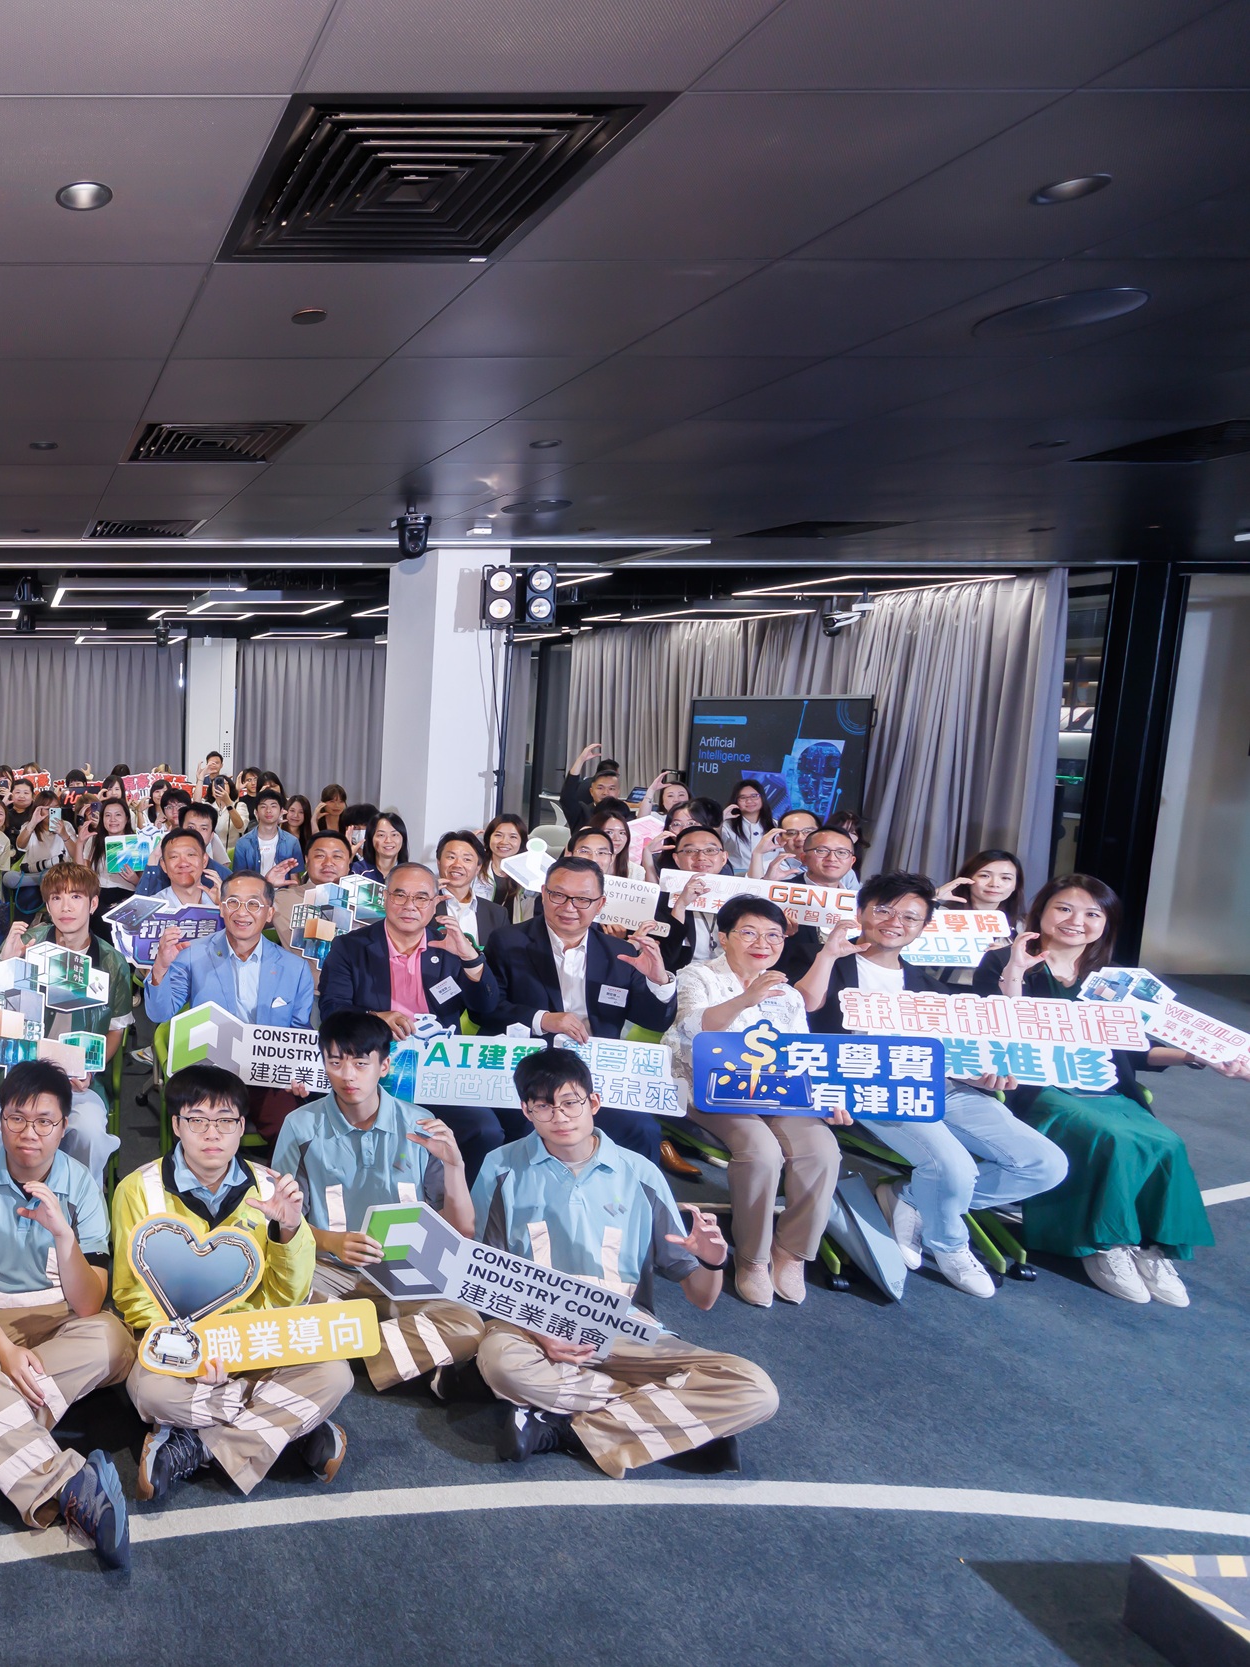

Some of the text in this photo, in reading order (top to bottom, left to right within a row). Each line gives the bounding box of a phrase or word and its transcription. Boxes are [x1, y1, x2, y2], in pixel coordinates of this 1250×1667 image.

[698, 750, 751, 763] Intelligence
[699, 736, 736, 748] Artificial
[697, 762, 719, 774] HUB
[603, 890, 647, 905] NSTITUTE
[631, 884, 657, 894] KONG
[768, 884, 828, 908] GEN
[835, 892, 856, 911] C
[843, 991, 1144, 1047] 兼讀制課程
[1164, 1003, 1247, 1047] WE BUILD
[253, 1028, 318, 1046] CONSTRU
[252, 1045, 321, 1062] INDUSTRY
[786, 1041, 933, 1082] 免學費
[944, 1037, 1111, 1087] 業進修
[249, 1061, 333, 1089] 建造業議
[810, 1083, 935, 1117] 有津貼
[471, 1247, 621, 1310] CONSTRUCTION
[457, 1280, 609, 1352] 建造業議會
[466, 1263, 650, 1342] INDUSTRY COUNCIL
[204, 1312, 364, 1364] 職業導向
